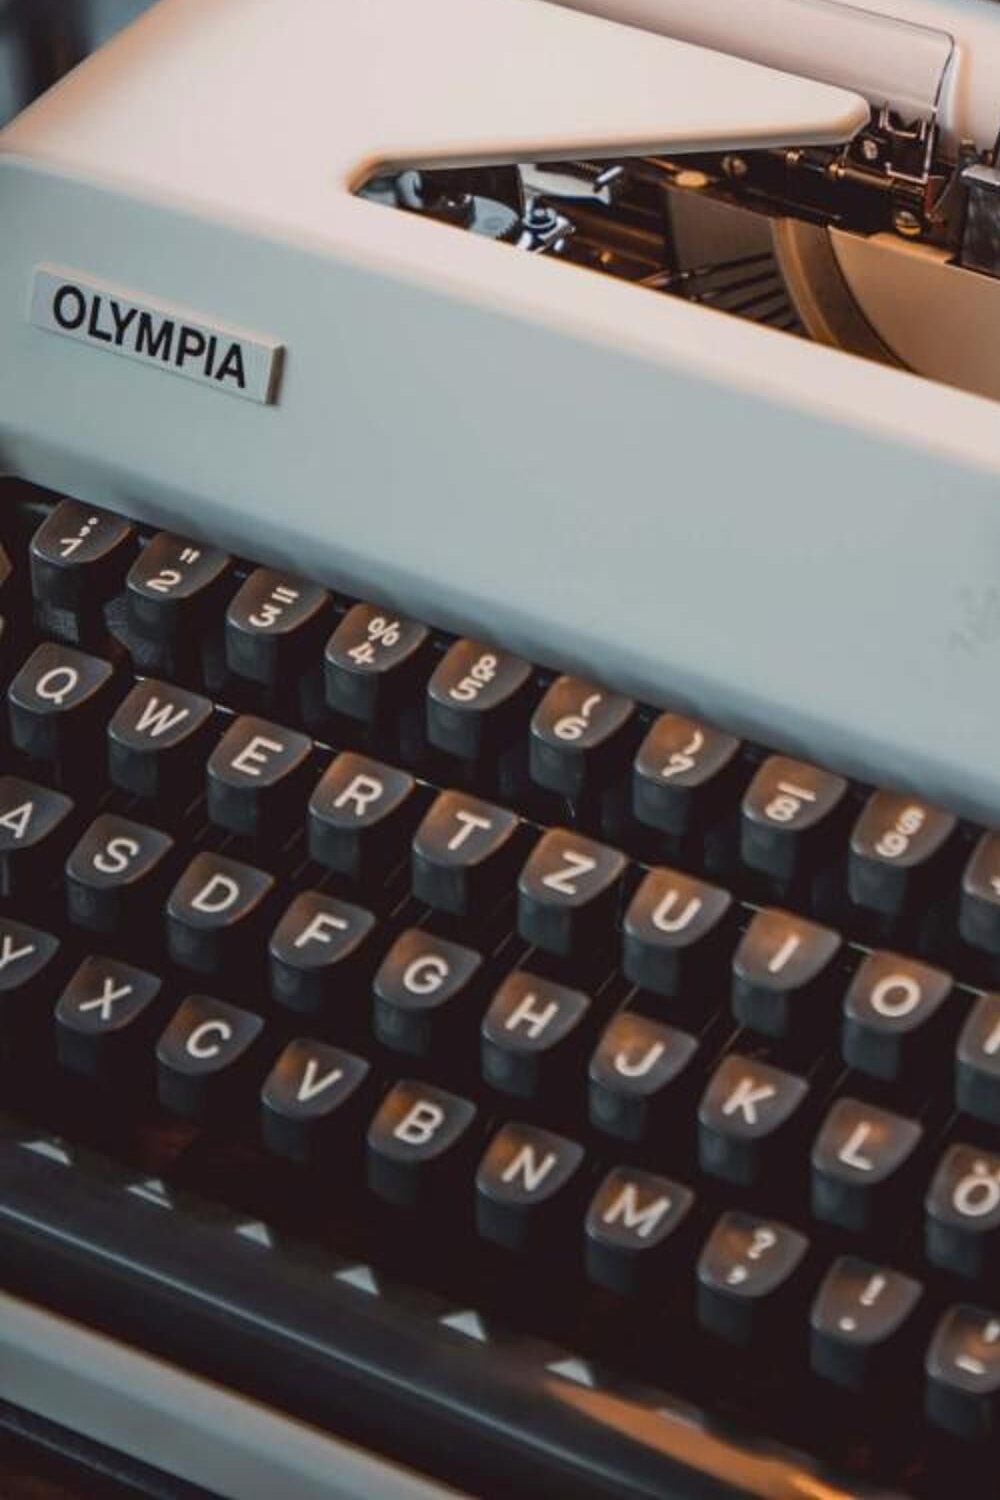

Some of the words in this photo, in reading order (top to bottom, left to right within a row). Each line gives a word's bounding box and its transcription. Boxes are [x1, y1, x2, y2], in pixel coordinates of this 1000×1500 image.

[52, 284, 246, 389] OLYMPIA
[60, 538, 83, 558] 1
[145, 569, 182, 593] 2
[248, 604, 282, 628] 3
[347, 641, 375, 665] 4
[35, 666, 78, 705] Q
[449, 677, 478, 702] 5
[135, 697, 190, 737] W
[554, 716, 587, 741] 6
[231, 736, 284, 776] E
[661, 753, 695, 778] 7
[334, 775, 383, 816] R
[765, 795, 801, 822] 8
[0, 802, 33, 839] A
[447, 811, 492, 851] T
[93, 838, 140, 874] S
[875, 827, 912, 858] 9
[542, 851, 596, 895] Z
[191, 874, 239, 913] D
[652, 891, 702, 932] U
[294, 913, 348, 948] F
[0, 936, 35, 969] Y
[769, 935, 800, 973] I
[403, 956, 449, 994] G
[78, 978, 133, 1021] X
[870, 976, 921, 1017] O
[505, 995, 559, 1039] H
[185, 1021, 232, 1059] C
[615, 1043, 665, 1077] J
[296, 1060, 343, 1102] V
[722, 1080, 775, 1125] K
[393, 1101, 444, 1145] B
[838, 1123, 873, 1171] L
[501, 1146, 557, 1192] N
[603, 1185, 671, 1238] M
